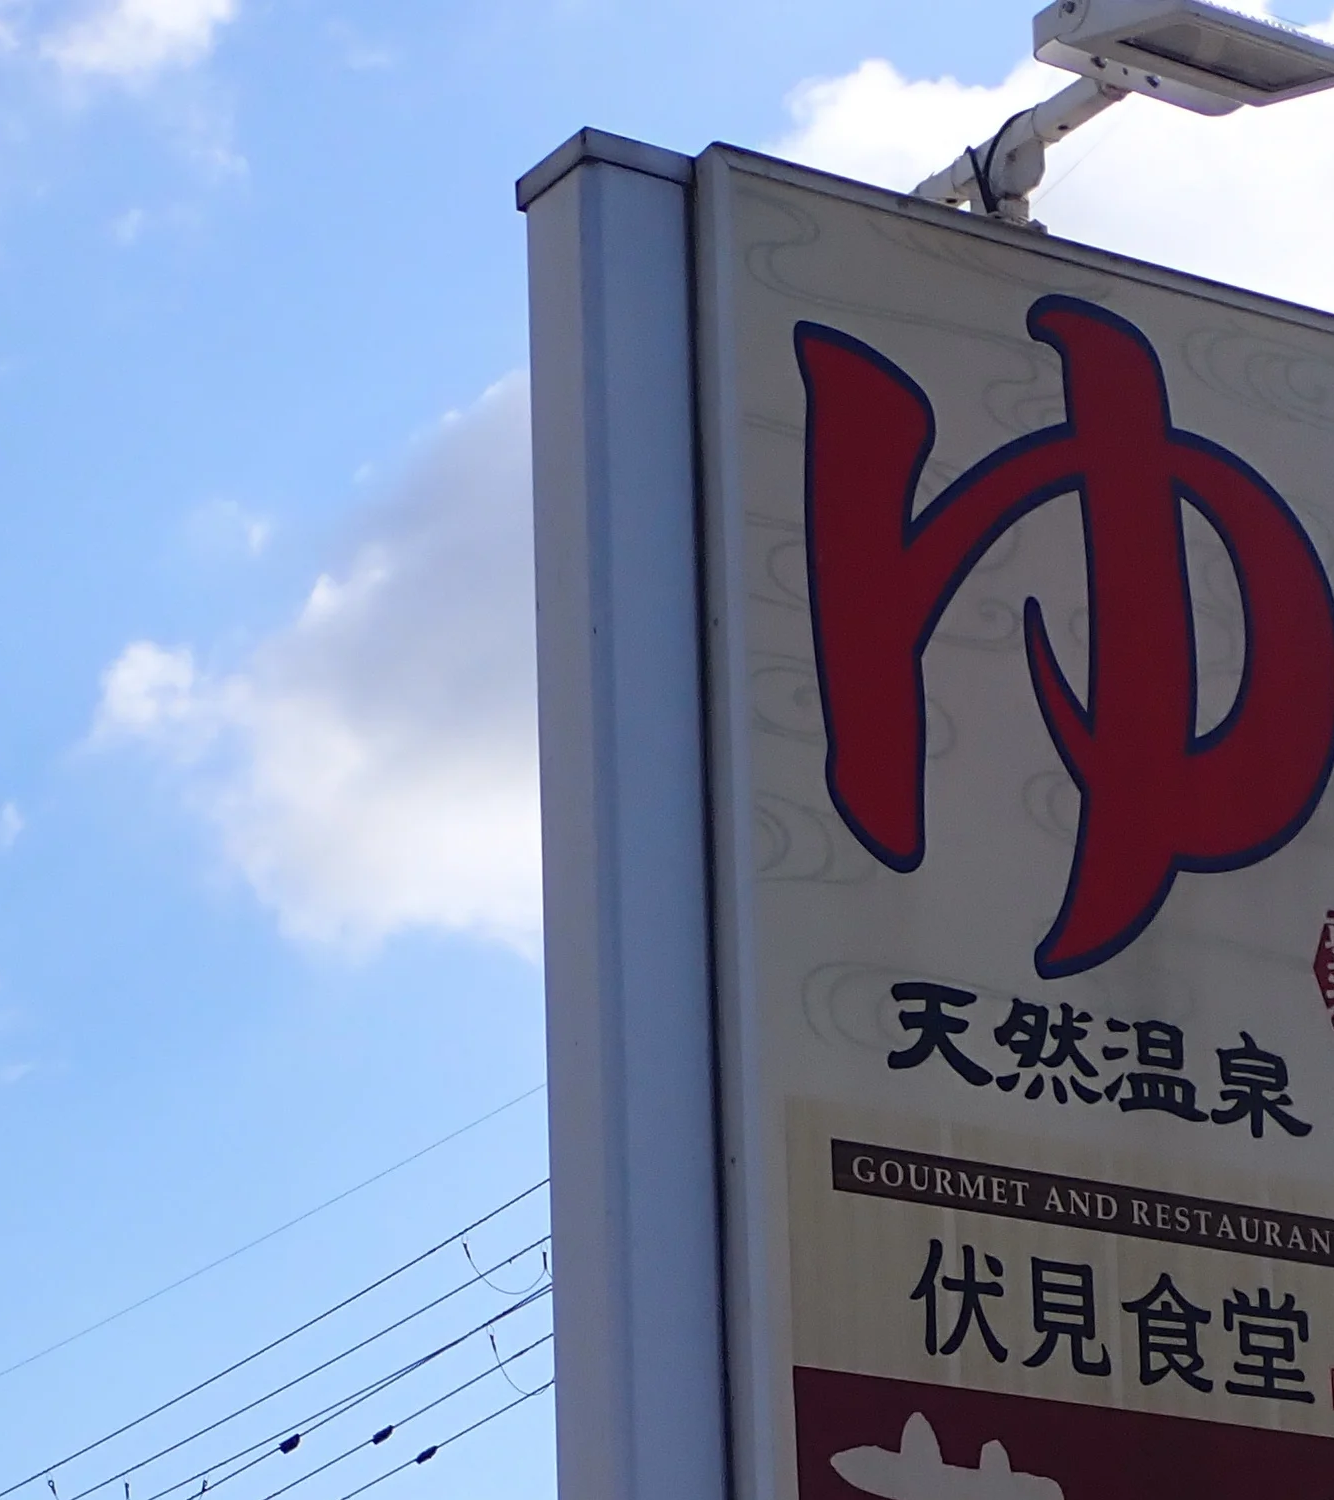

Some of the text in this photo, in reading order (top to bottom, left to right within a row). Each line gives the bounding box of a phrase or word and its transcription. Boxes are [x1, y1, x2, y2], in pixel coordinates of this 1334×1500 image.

[887, 981, 1312, 1138] 天然温泉
[851, 1155, 1029, 1207] GOURMET
[1044, 1185, 1118, 1220] AND
[910, 1239, 1315, 1403] 伏見食堂
